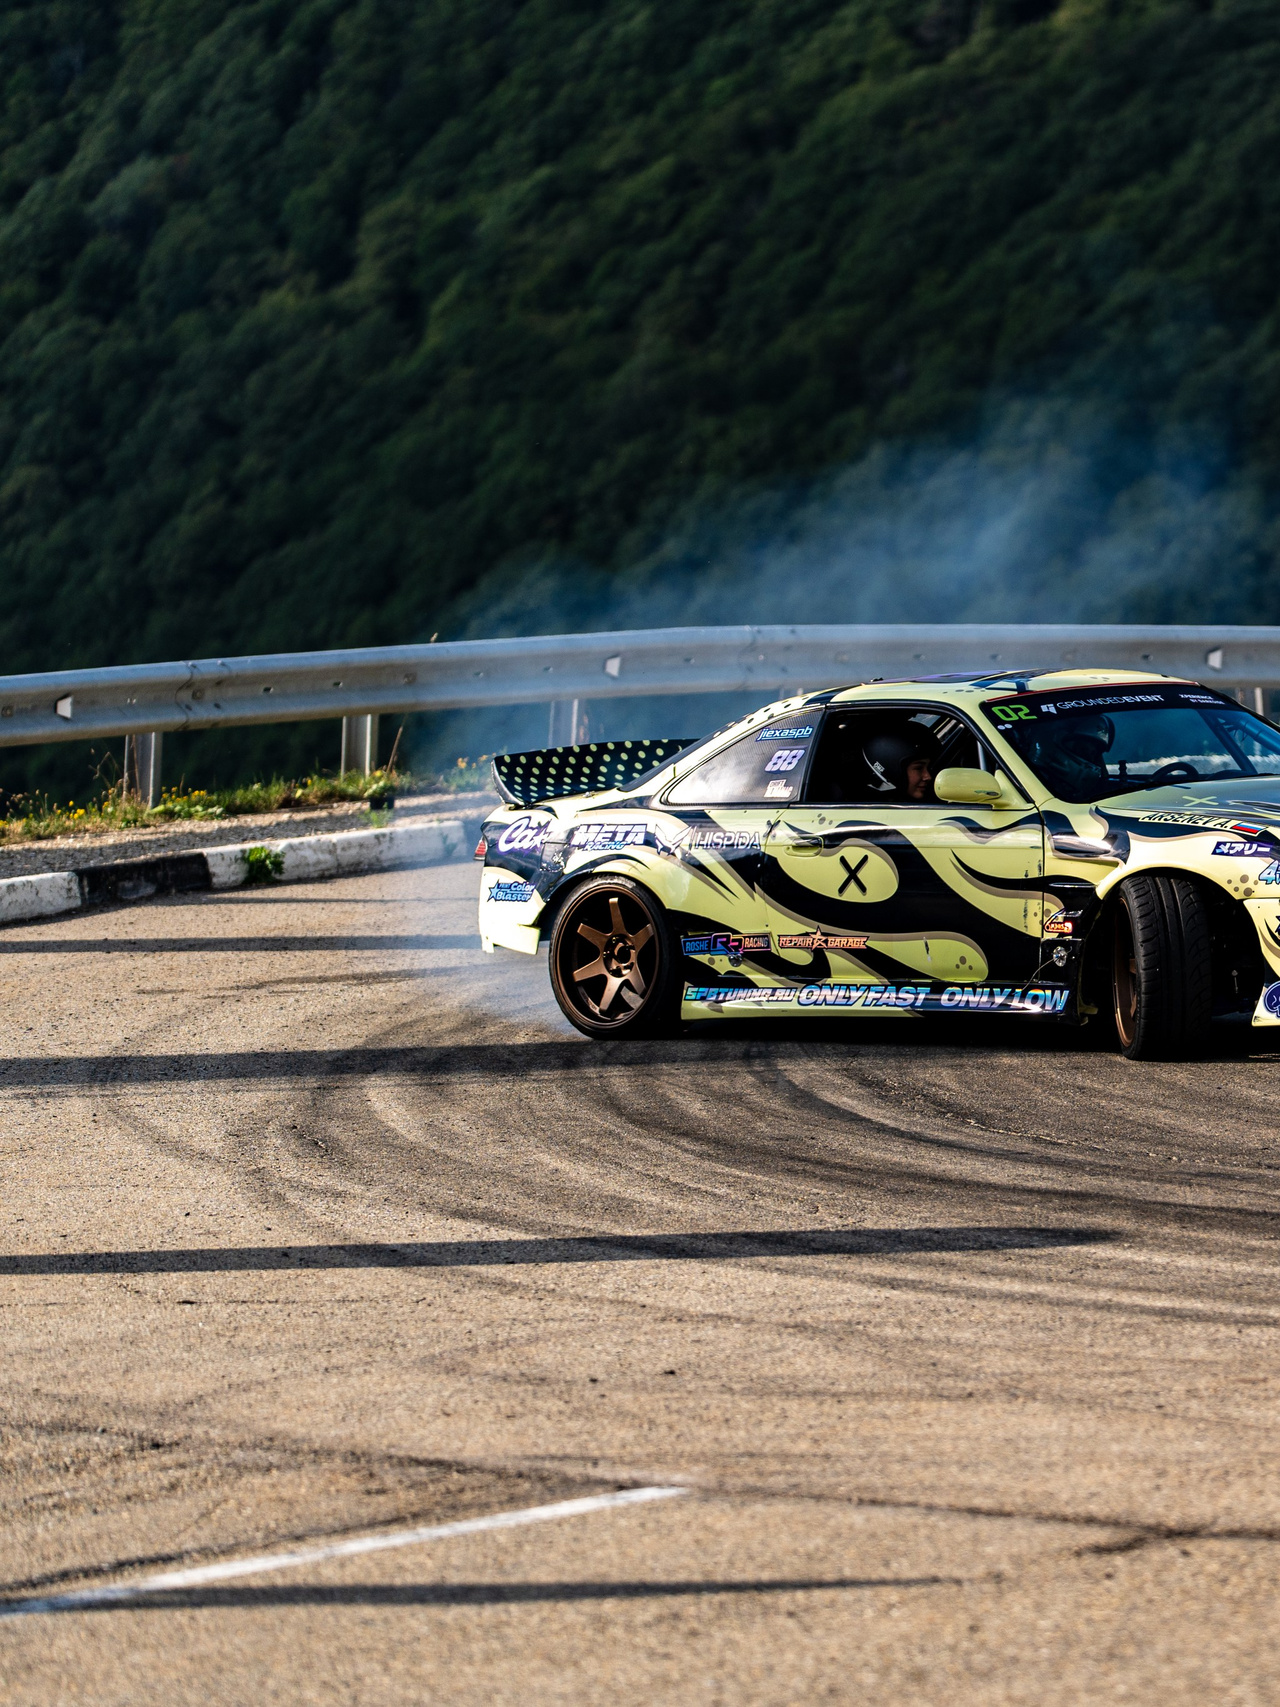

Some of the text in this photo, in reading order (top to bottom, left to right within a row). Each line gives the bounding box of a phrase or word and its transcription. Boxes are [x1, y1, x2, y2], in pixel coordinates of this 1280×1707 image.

[992, 704, 1038, 721] 02
[757, 726, 814, 741] jiexaspb
[764, 749, 806, 773] 88
[571, 823, 648, 846] META
[694, 831, 761, 850] HISPIDA
[583, 841, 627, 851] RACING
[1259, 860, 1279, 885] 4
[511, 883, 535, 891] Color
[496, 891, 531, 900] Blaster
[686, 940, 709, 951] ROSHE
[780, 937, 812, 947] REPAIR
[828, 937, 866, 947] GARAGE
[685, 987, 797, 1001] SPBTUNING.RU
[799, 985, 867, 1005] ONLY
[862, 986, 930, 1006] FAST
[940, 987, 1016, 1007] ONLY
